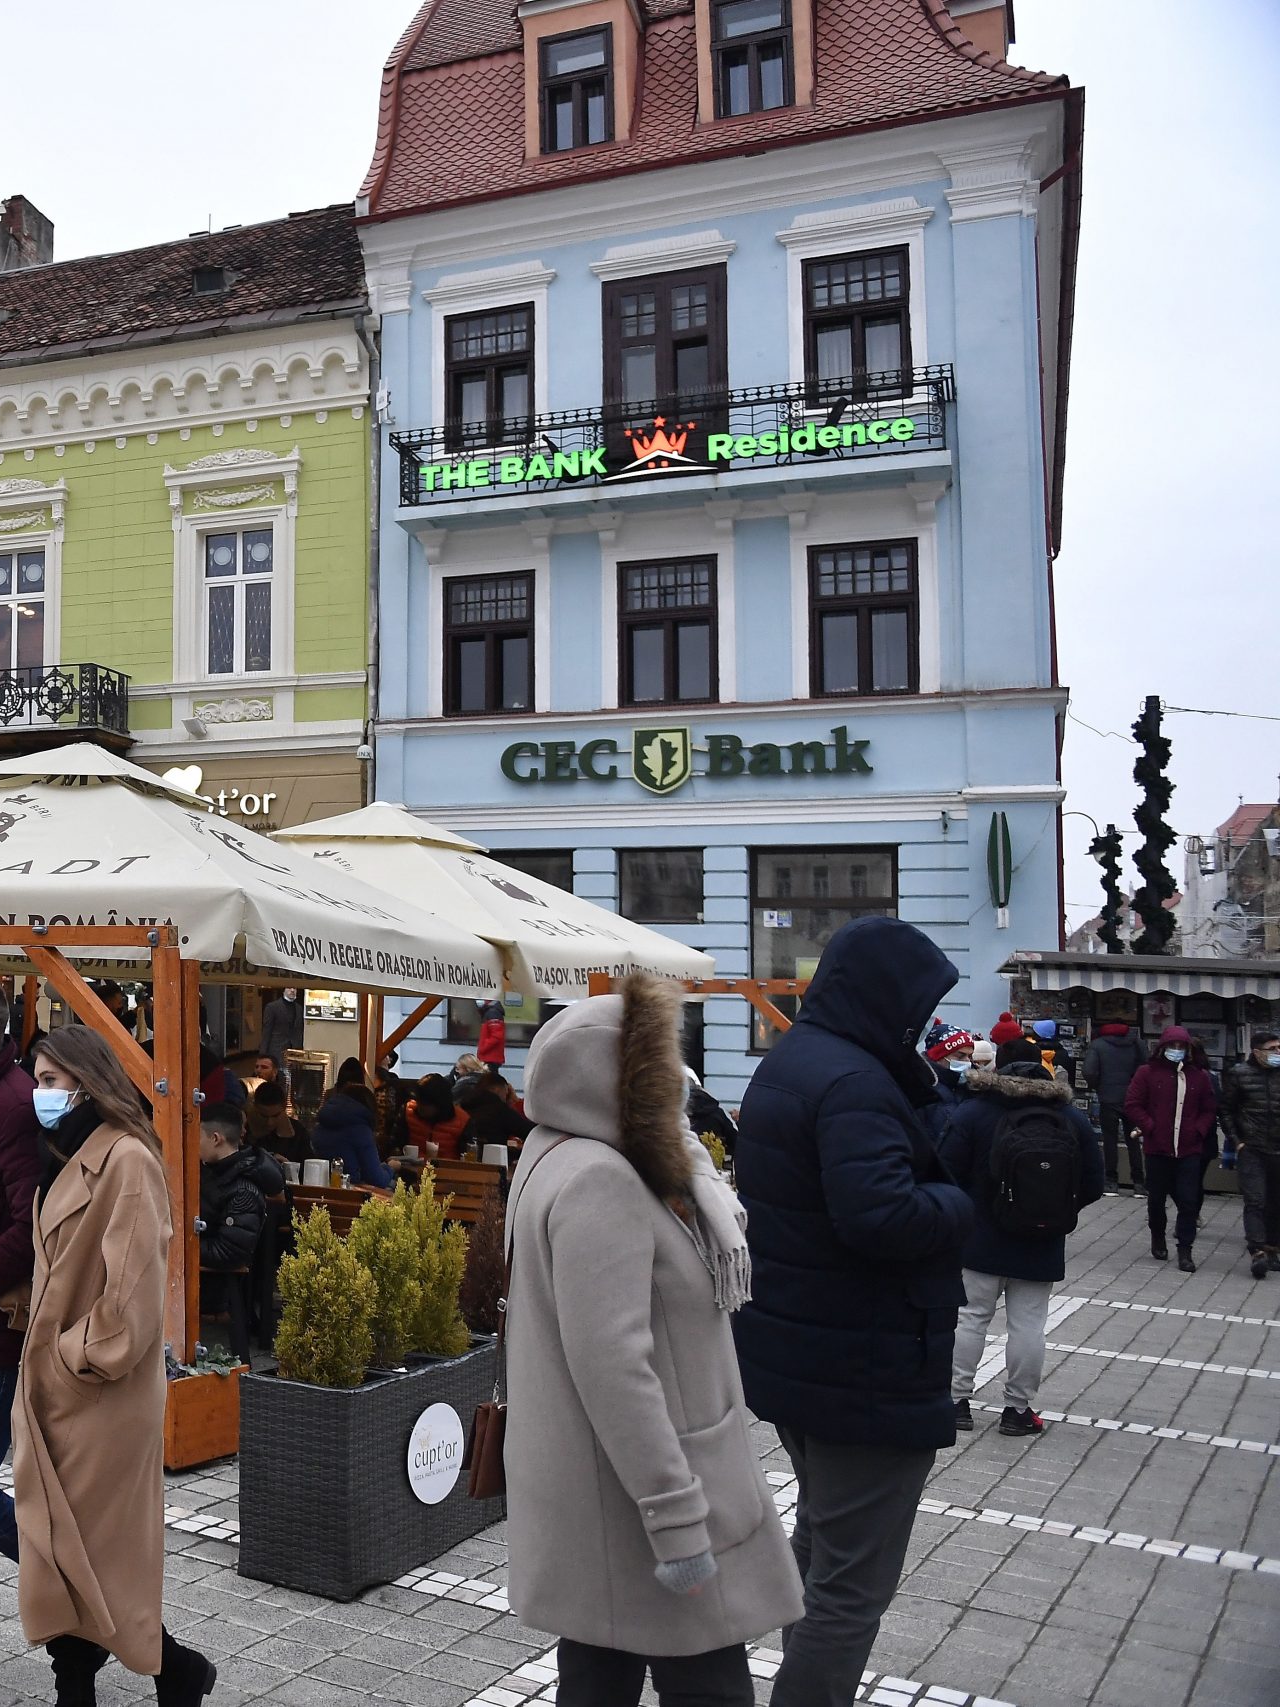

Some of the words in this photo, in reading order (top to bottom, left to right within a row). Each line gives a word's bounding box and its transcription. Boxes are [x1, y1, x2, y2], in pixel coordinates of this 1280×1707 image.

[420, 460, 490, 491] THE
[501, 448, 607, 483] BANK
[708, 417, 914, 461] Residence
[500, 739, 618, 783] CEC
[705, 725, 873, 777] Bank
[271, 927, 326, 964] BRAȘOV.
[329, 942, 373, 971] REGELE
[377, 951, 431, 981] ORAȘELOR
[434, 956, 445, 982] ÎN
[448, 962, 497, 989] ROMÂNIA.
[945, 1036, 966, 1050] Cool
[415, 1440, 457, 1470] cupt'or
